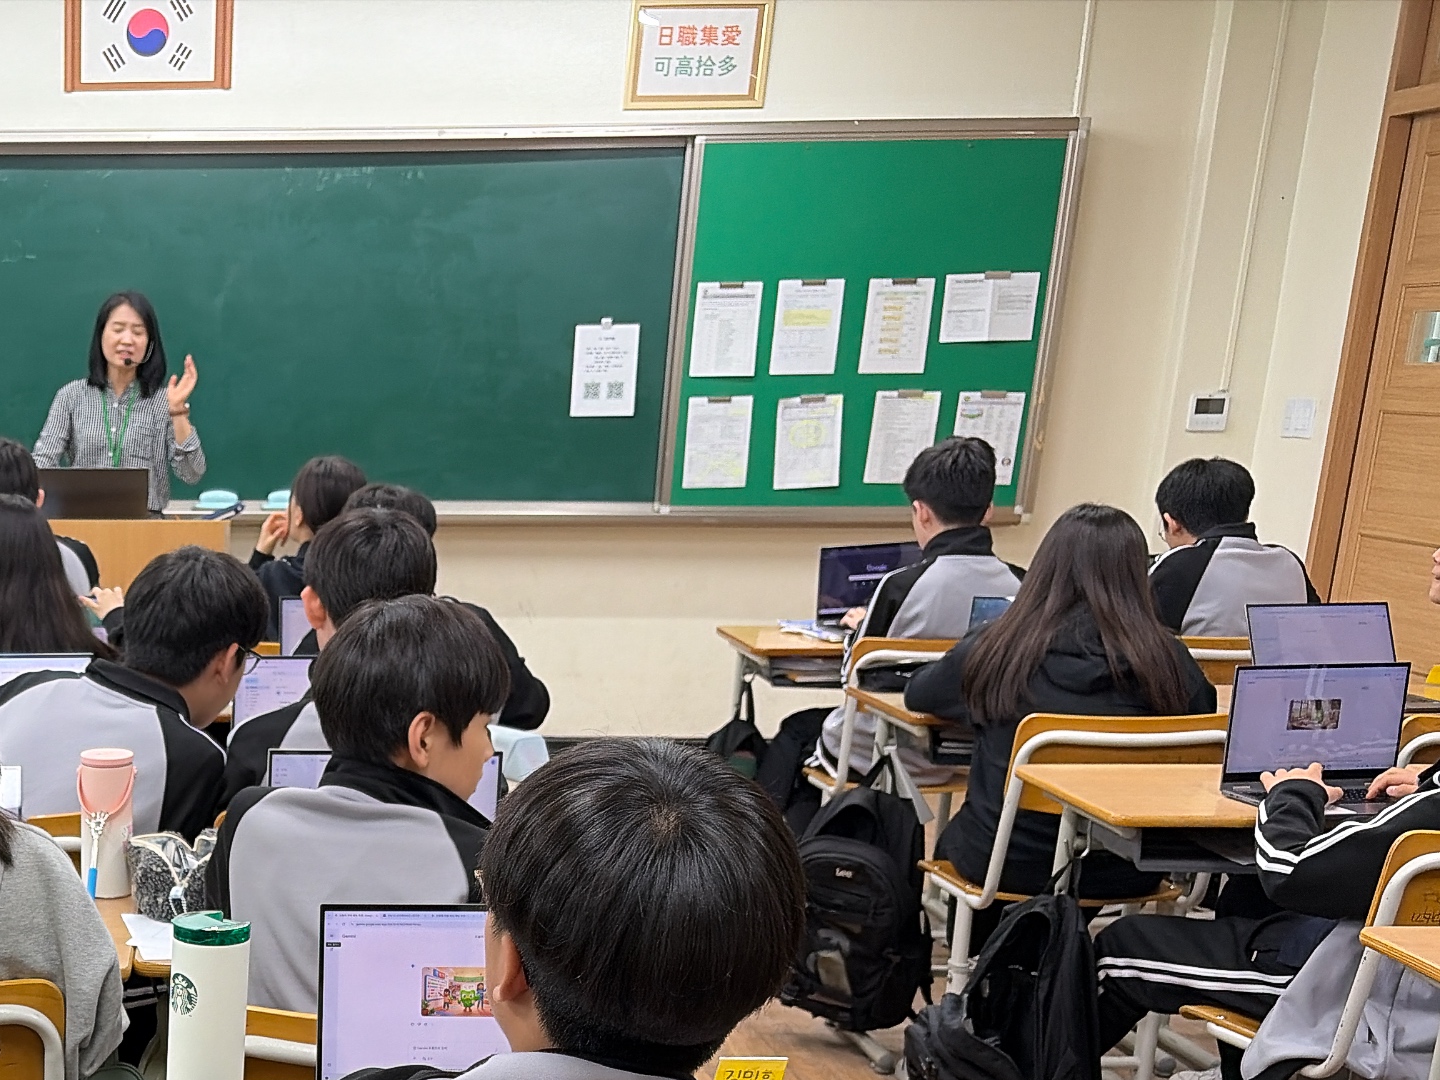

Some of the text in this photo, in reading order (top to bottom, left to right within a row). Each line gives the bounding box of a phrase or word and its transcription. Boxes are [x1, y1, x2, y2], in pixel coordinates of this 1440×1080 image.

[658, 24, 741, 46] 日職集愛
[654, 55, 737, 77] 可高拾多
